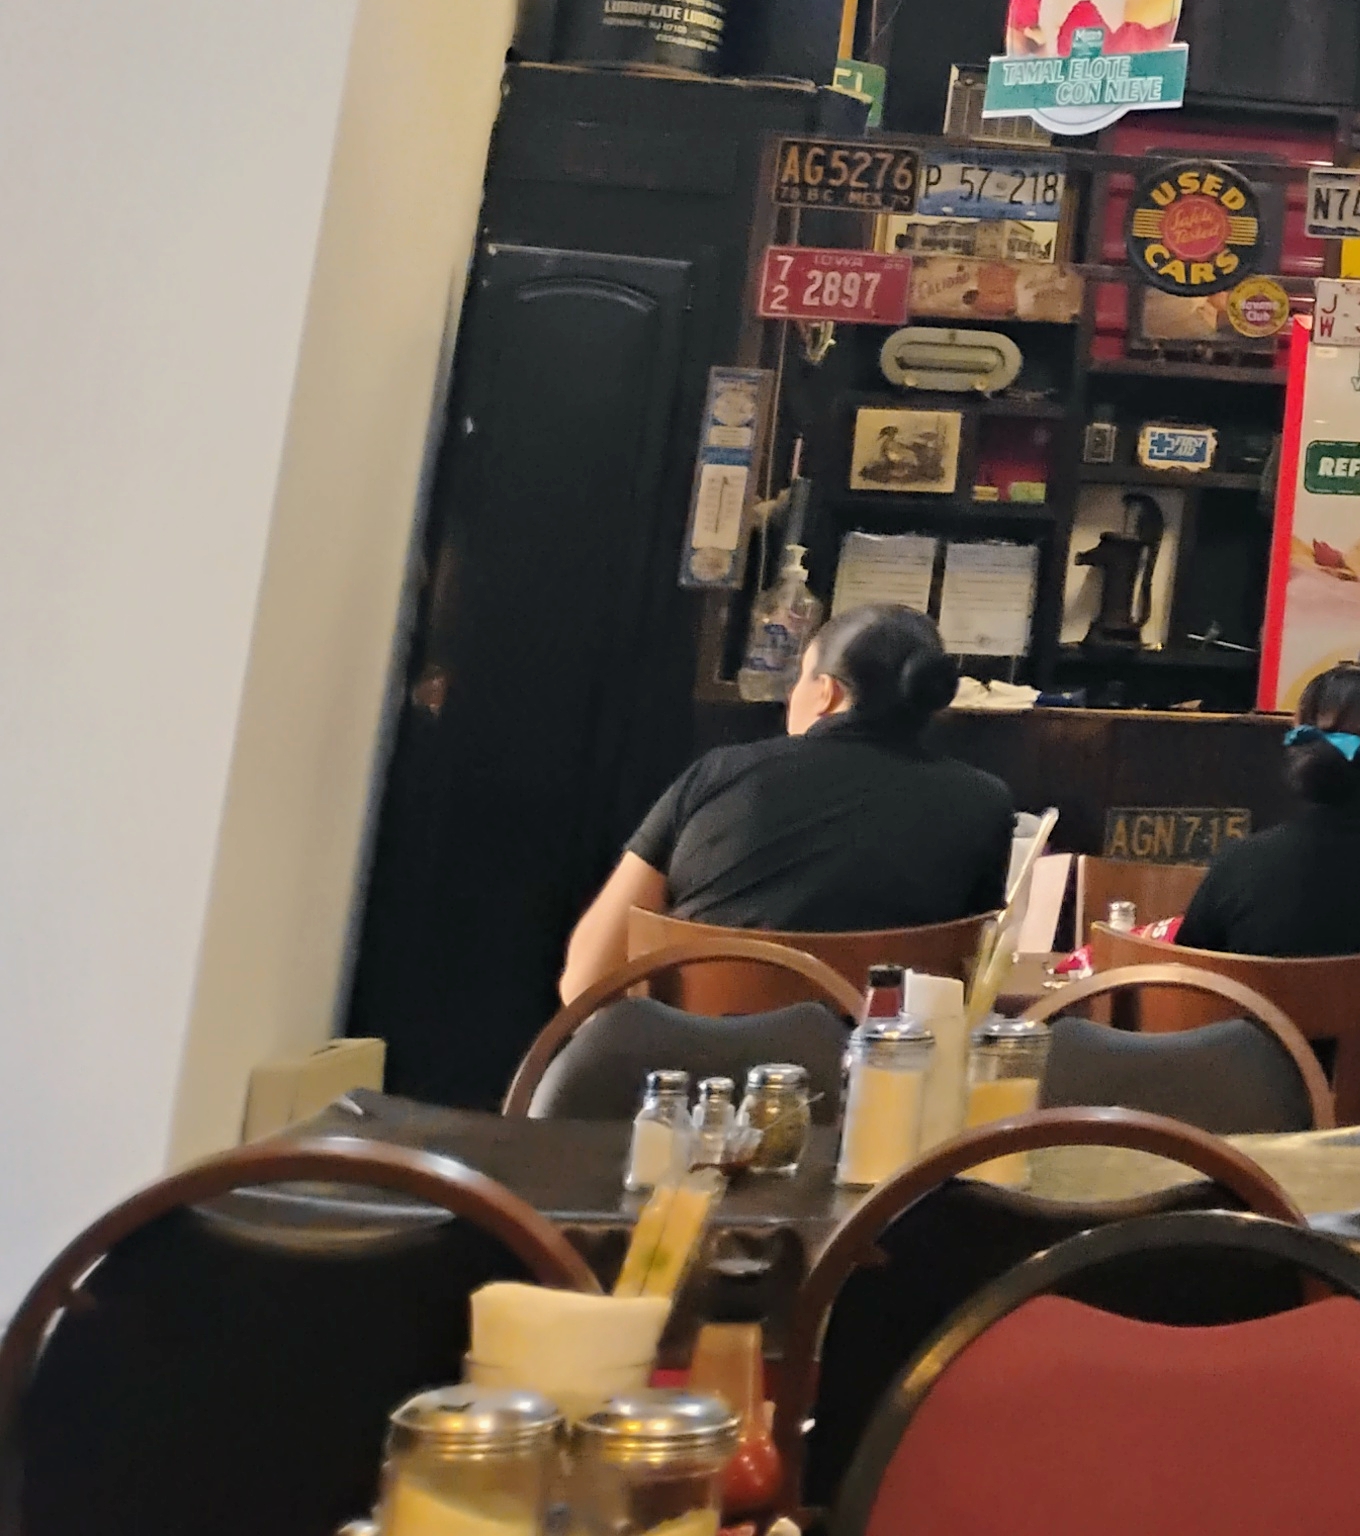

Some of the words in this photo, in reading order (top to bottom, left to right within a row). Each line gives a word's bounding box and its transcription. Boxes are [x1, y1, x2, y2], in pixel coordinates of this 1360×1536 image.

[1003, 59, 1064, 86] TAMAL
[1068, 55, 1132, 82] ELOTE
[1056, 80, 1102, 106] CON
[1104, 76, 1163, 103] NIEVE
[780, 145, 914, 191] AG5276
[923, 164, 942, 200] P
[1150, 171, 1247, 210] USED
[1144, 243, 1240, 285] CARS
[802, 269, 882, 310] 2897
